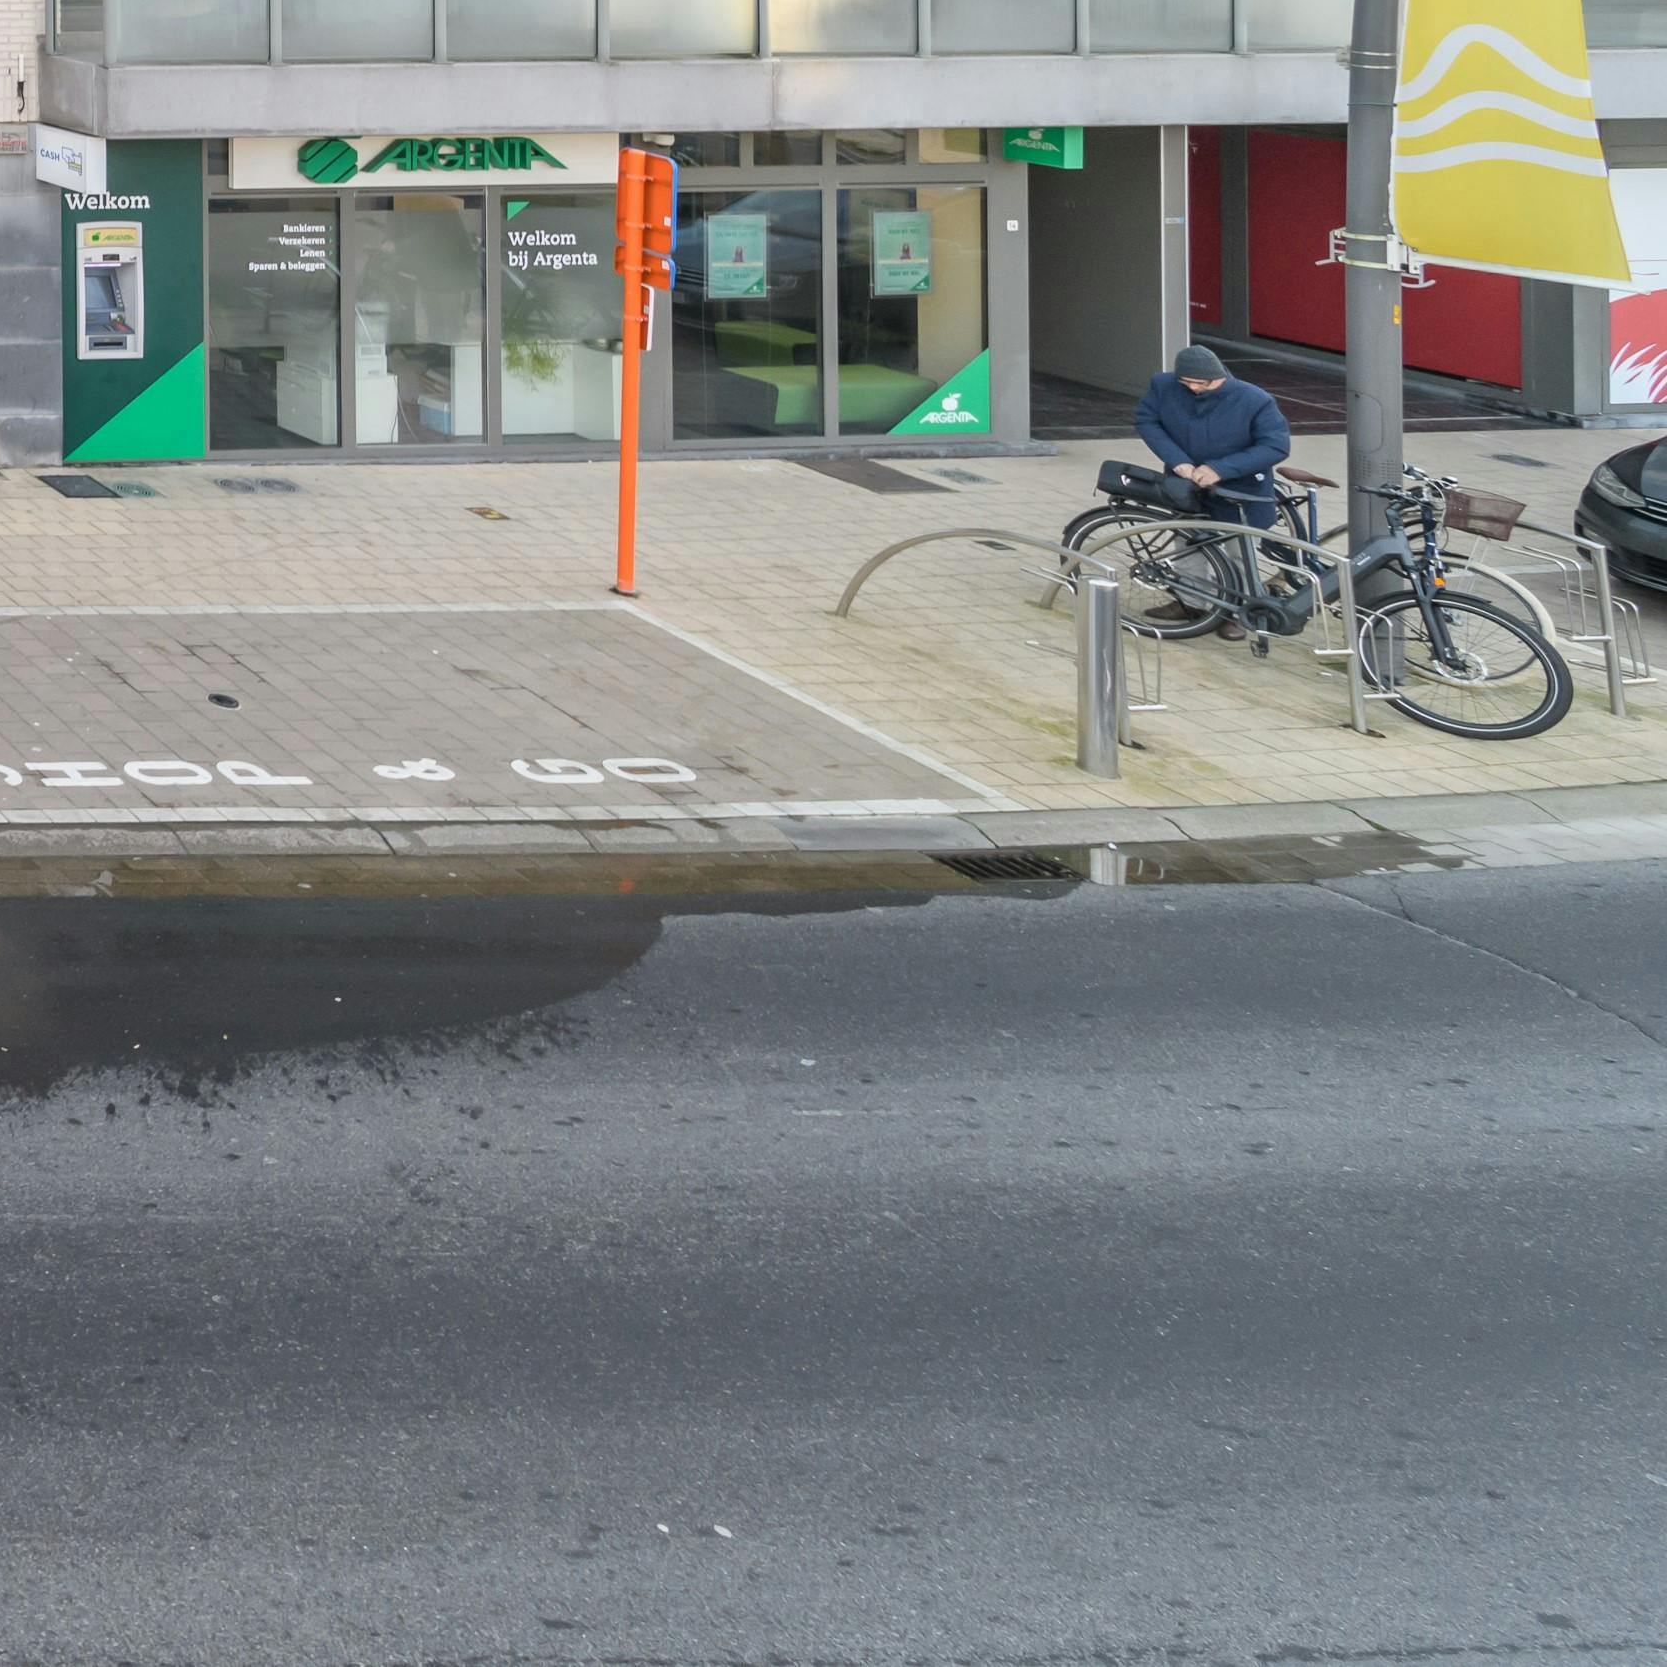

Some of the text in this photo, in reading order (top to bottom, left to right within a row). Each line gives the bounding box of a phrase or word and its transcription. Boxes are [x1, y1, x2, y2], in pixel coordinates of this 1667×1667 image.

[1009, 138, 1060, 153] ARGENTA
[40, 148, 60, 161] CASH
[359, 137, 568, 173] ARGENTA
[65, 191, 150, 210] Welkom
[283, 223, 326, 233] Bankieren
[278, 236, 326, 246] Verzekeren
[508, 231, 577, 246] Welkom
[299, 249, 326, 258] Lenen
[508, 251, 597, 270] bij Argenta
[249, 261, 326, 273] Sparen & beleggen
[919, 412, 979, 424] ARGENTA
[372, 758, 456, 781] &
[511, 758, 696, 785] GO
